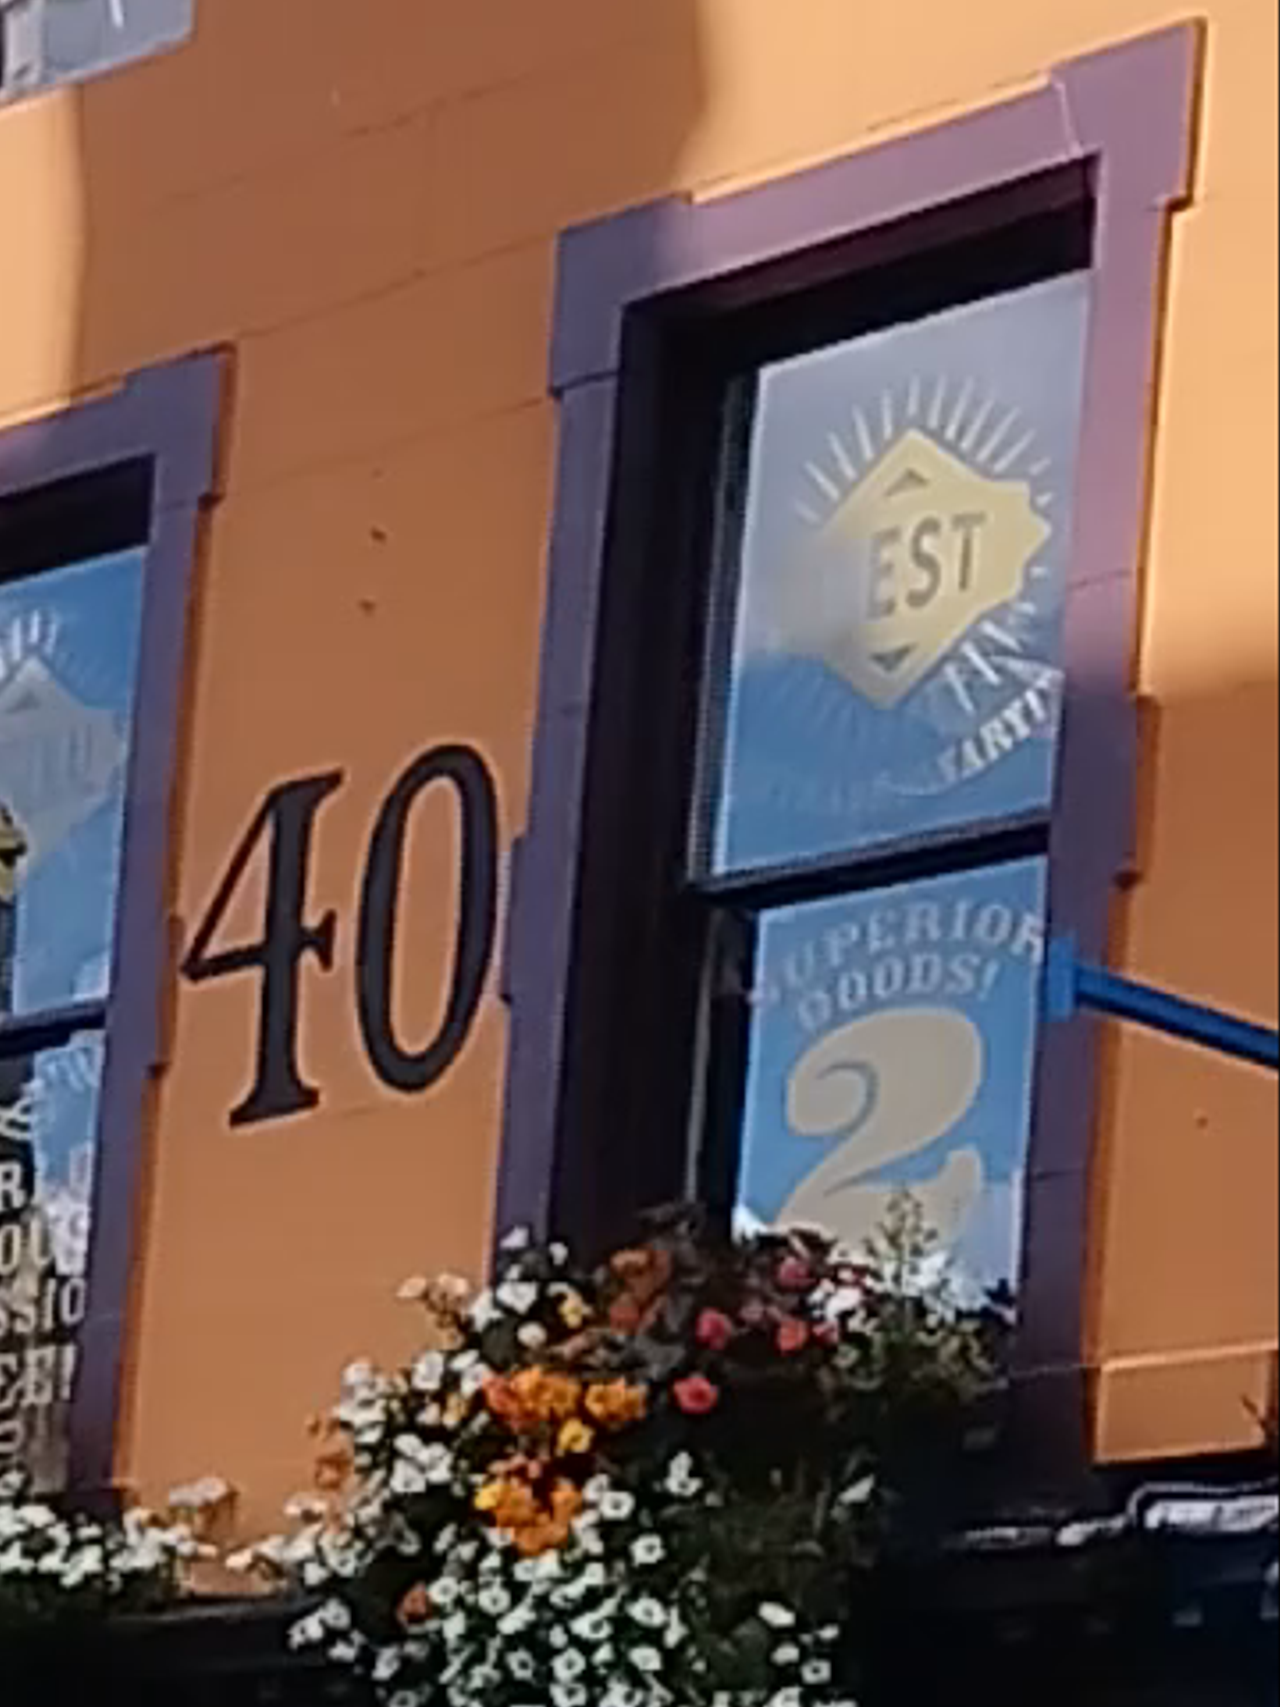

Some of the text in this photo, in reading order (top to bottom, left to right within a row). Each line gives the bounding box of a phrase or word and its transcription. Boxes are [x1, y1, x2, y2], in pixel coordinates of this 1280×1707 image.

[864, 510, 987, 621] EST
[179, 742, 498, 1129] 40
[796, 947, 1000, 1031] GOODS!
[774, 1005, 984, 1245] 2
